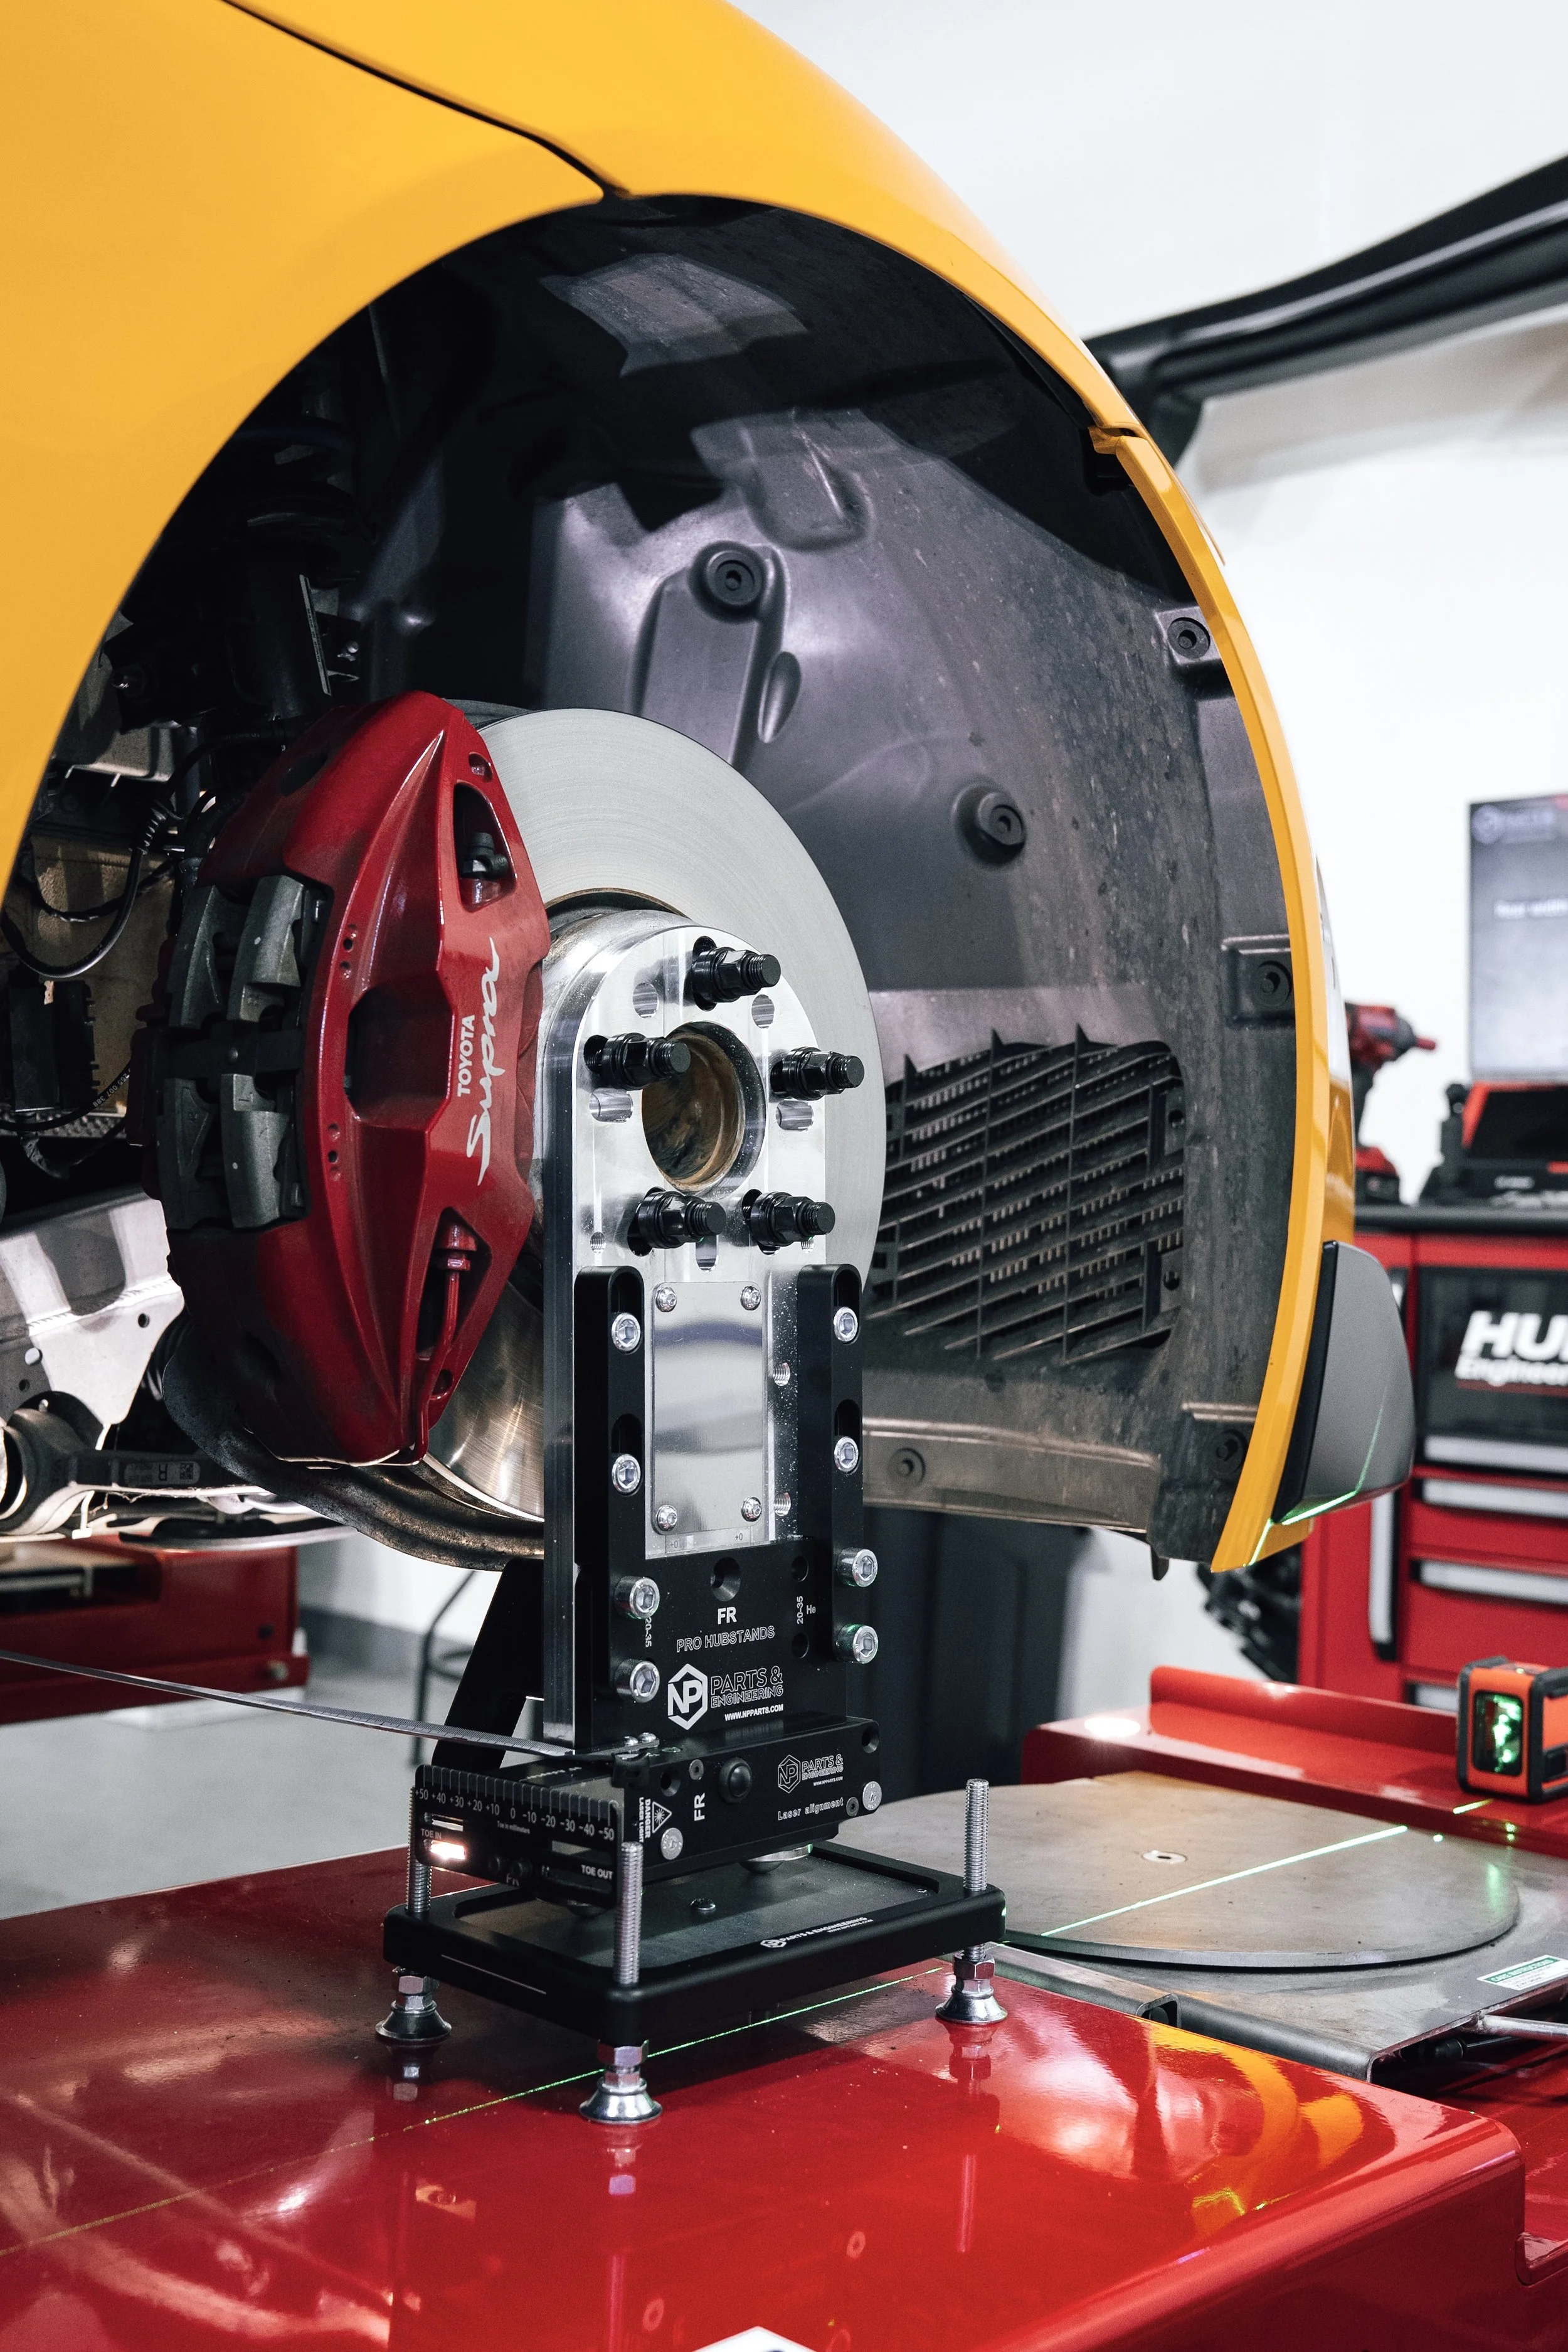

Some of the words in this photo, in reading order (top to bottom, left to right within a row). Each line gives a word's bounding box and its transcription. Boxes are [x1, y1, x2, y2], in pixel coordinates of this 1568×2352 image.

[457, 1014, 475, 1097] TOYOTA
[466, 937, 506, 1186] Supra
[106, 1085, 118, 1097] 007
[1461, 1310, 1568, 1363] HU
[718, 1606, 737, 1624] FR
[676, 1636, 702, 1652] PRO
[704, 1626, 775, 1648] HUBSTANDS
[711, 1668, 768, 1695] PARTS
[770, 1666, 783, 1685] &
[711, 1684, 784, 1708] ENGINEERING
[724, 1703, 784, 1721] WWW.NPPARTS.COM
[802, 1755, 834, 1773] PARTS
[835, 1753, 844, 1766] &
[802, 1765, 844, 1780] ENGINEERING
[415, 1789, 429, 1801] +50
[432, 1792, 447, 1805] +40
[449, 1796, 464, 1808] +30
[467, 1799, 482, 1812] +20
[485, 1803, 500, 1816] +10
[510, 1807, 516, 1819] 0
[522, 1811, 538, 1824] -10
[541, 1814, 556, 1829] -20
[559, 1819, 576, 1833] -30
[579, 1823, 595, 1837] -40
[598, 1828, 615, 1842] -50
[694, 1792, 706, 1821] FR
[778, 1808, 802, 1821] Laser
[805, 1797, 844, 1814] alignment
[421, 1828, 435, 1838] TOE
[435, 1831, 442, 1839] IN
[580, 1863, 596, 1876] TOE
[597, 1868, 614, 1881] OUT
